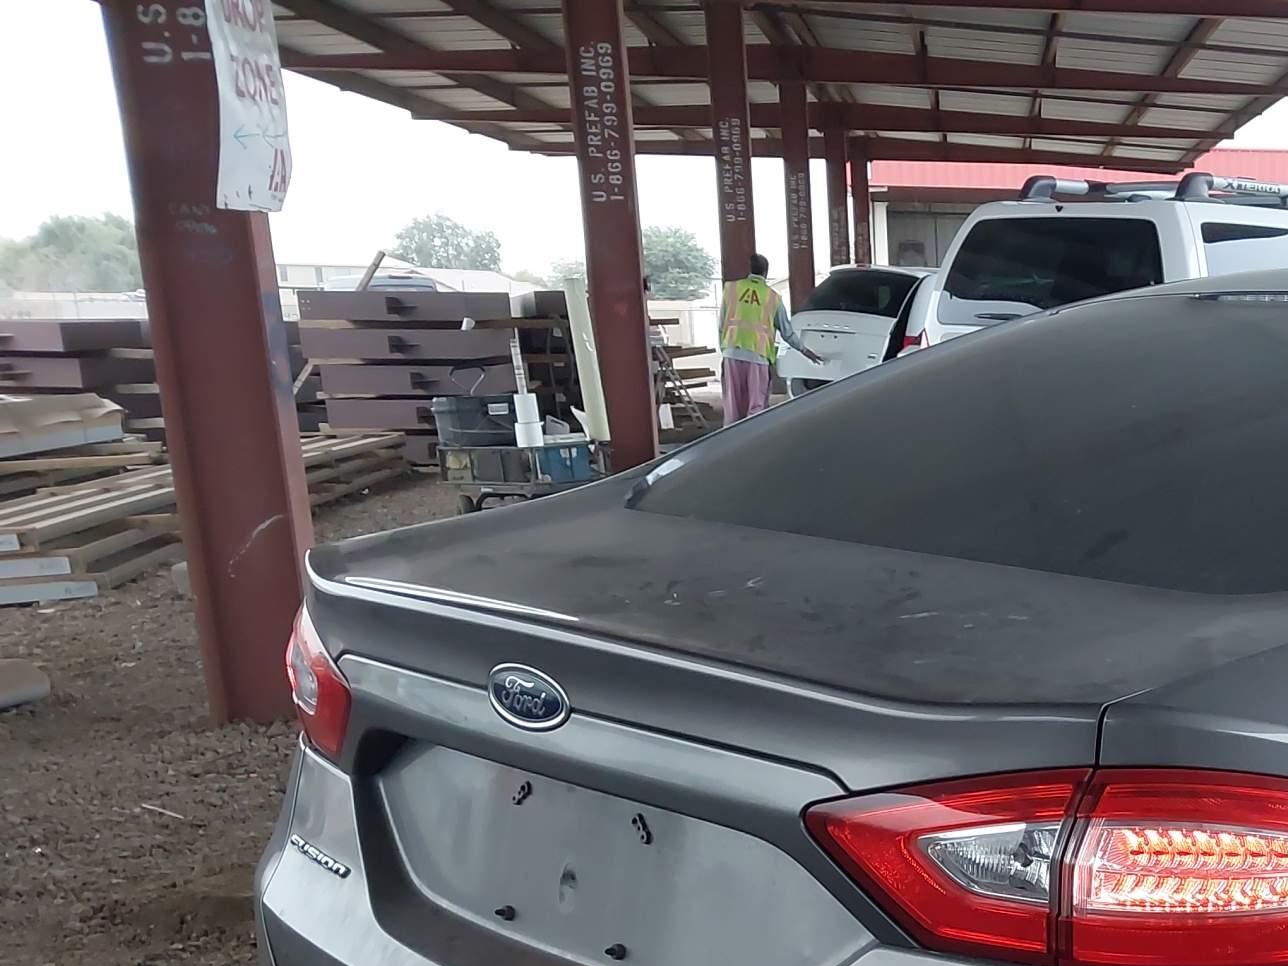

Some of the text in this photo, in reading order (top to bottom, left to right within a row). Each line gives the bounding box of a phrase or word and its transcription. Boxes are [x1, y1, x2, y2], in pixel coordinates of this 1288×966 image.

[230, 54, 279, 106] ZONE
[579, 41, 597, 76] INC.
[583, 86, 603, 157] PREFAB
[597, 42, 625, 200] 1-866-799-0969
[501, 674, 548, 717] Ford
[290, 833, 352, 879] FUSION
